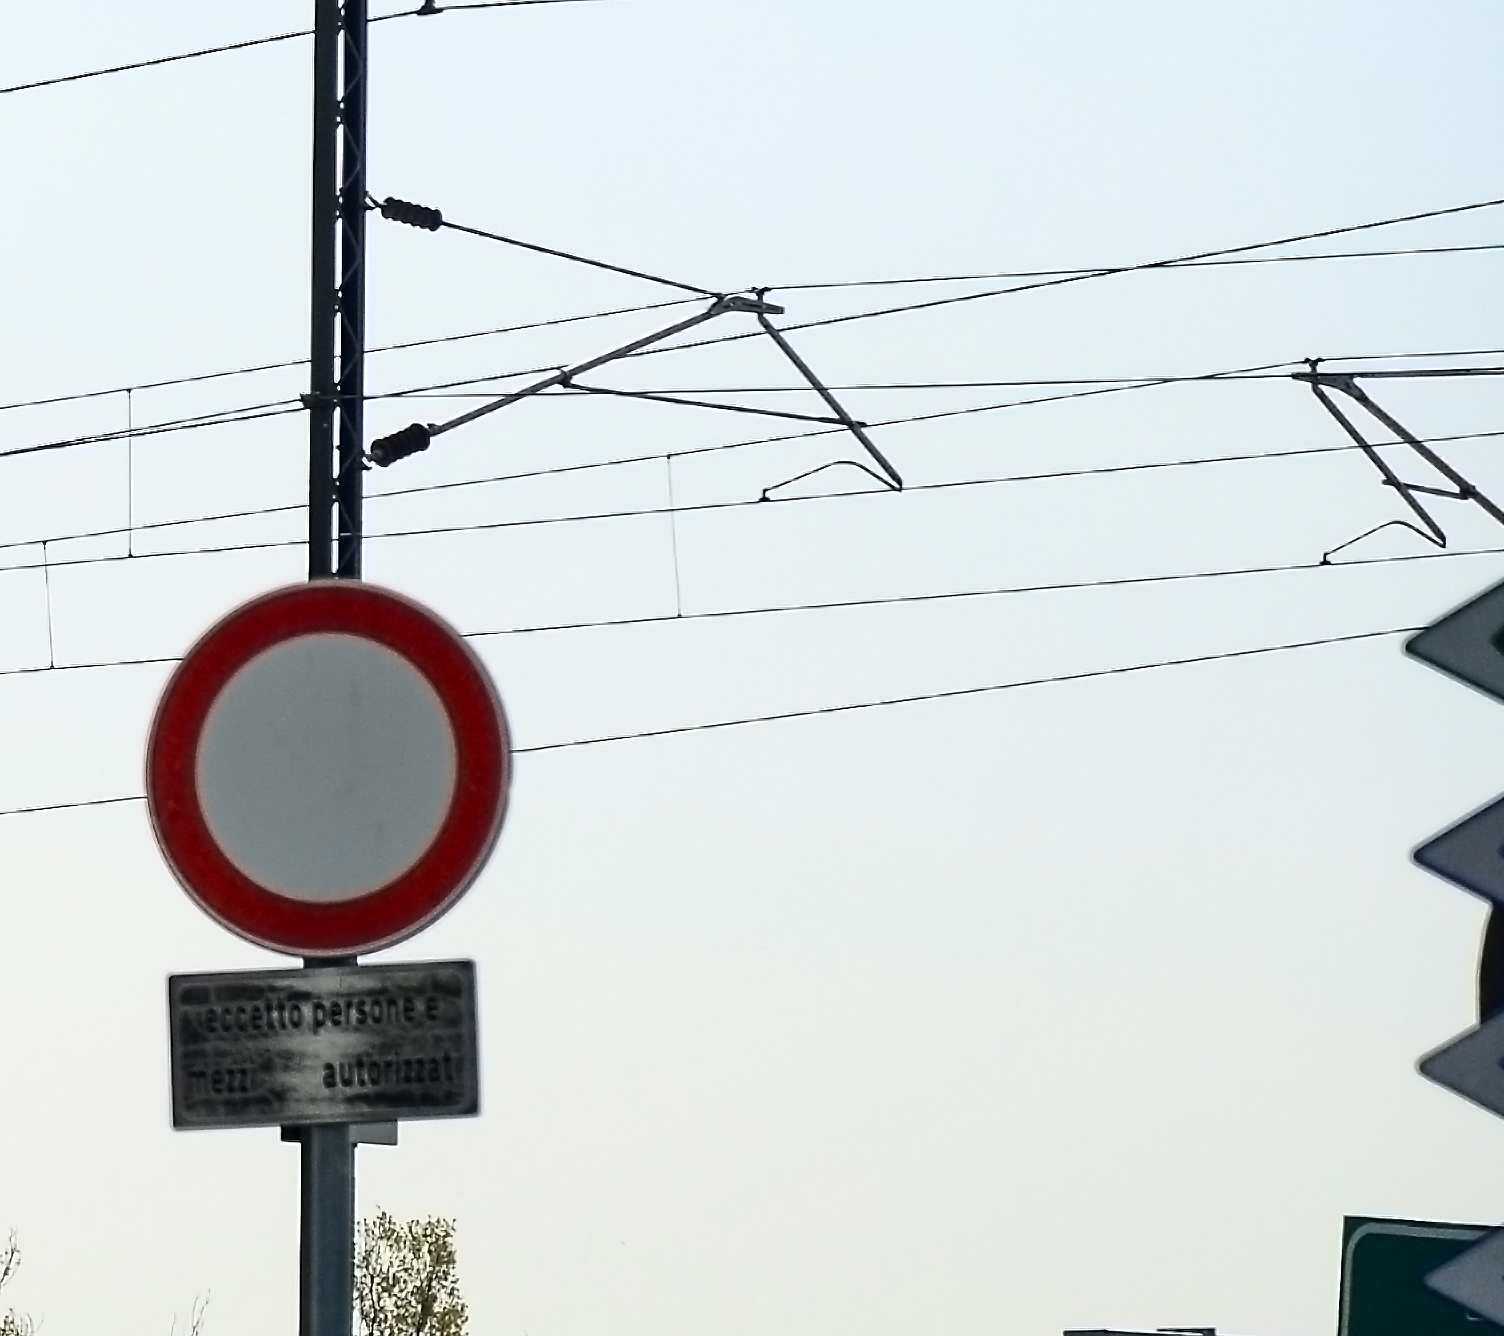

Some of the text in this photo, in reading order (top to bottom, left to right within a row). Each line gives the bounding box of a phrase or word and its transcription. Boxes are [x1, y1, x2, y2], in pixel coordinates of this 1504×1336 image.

[204, 994, 439, 1035] eccetto persone e
